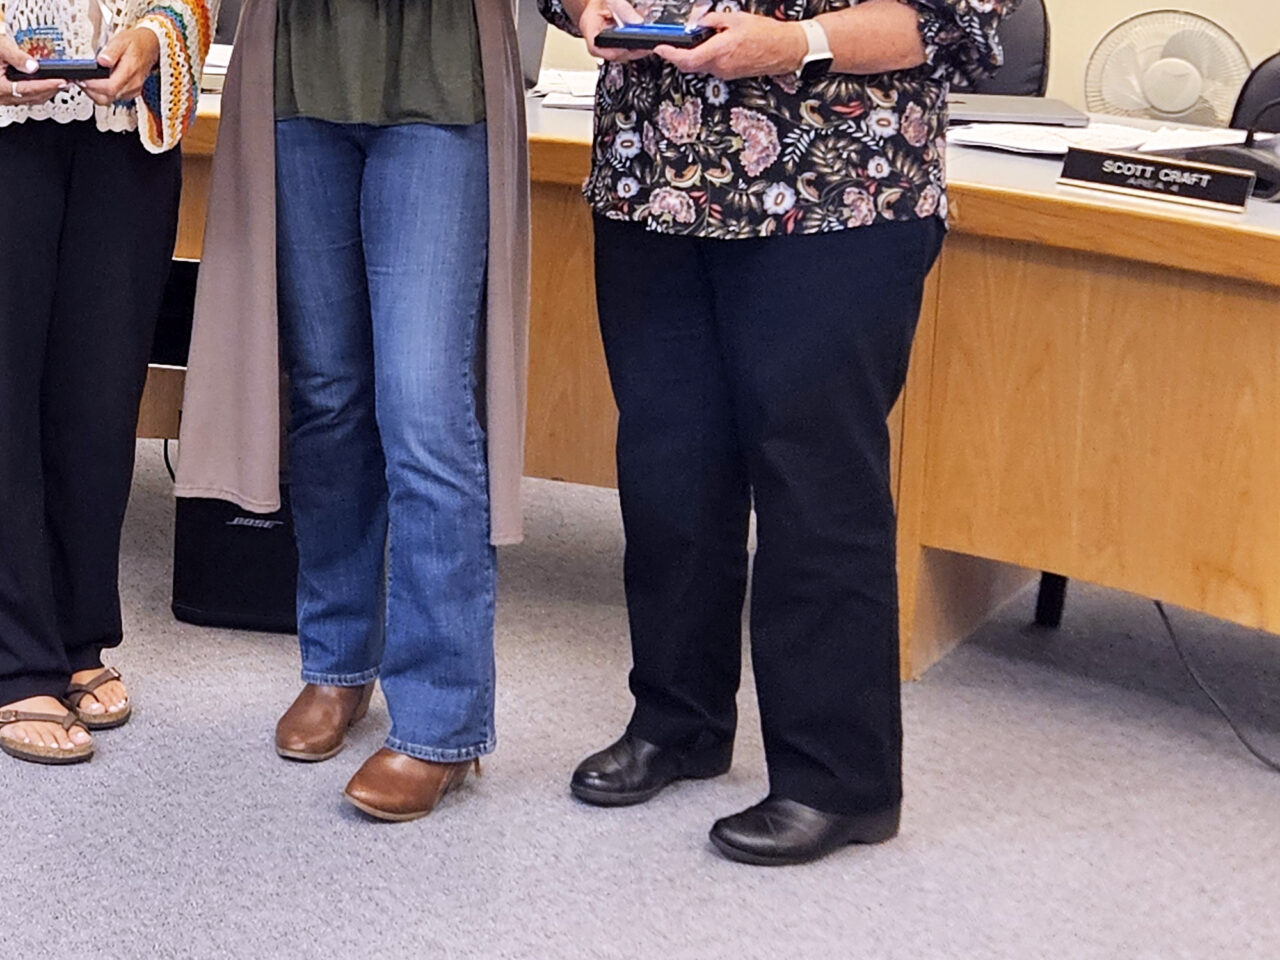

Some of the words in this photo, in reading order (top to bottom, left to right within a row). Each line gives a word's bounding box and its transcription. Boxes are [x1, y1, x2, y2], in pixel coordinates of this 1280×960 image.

[1101, 159, 1155, 179] SCOTT
[1159, 168, 1213, 189] CRAFT
[1125, 176, 1165, 190] AREA
[228, 516, 278, 528] BOSE
